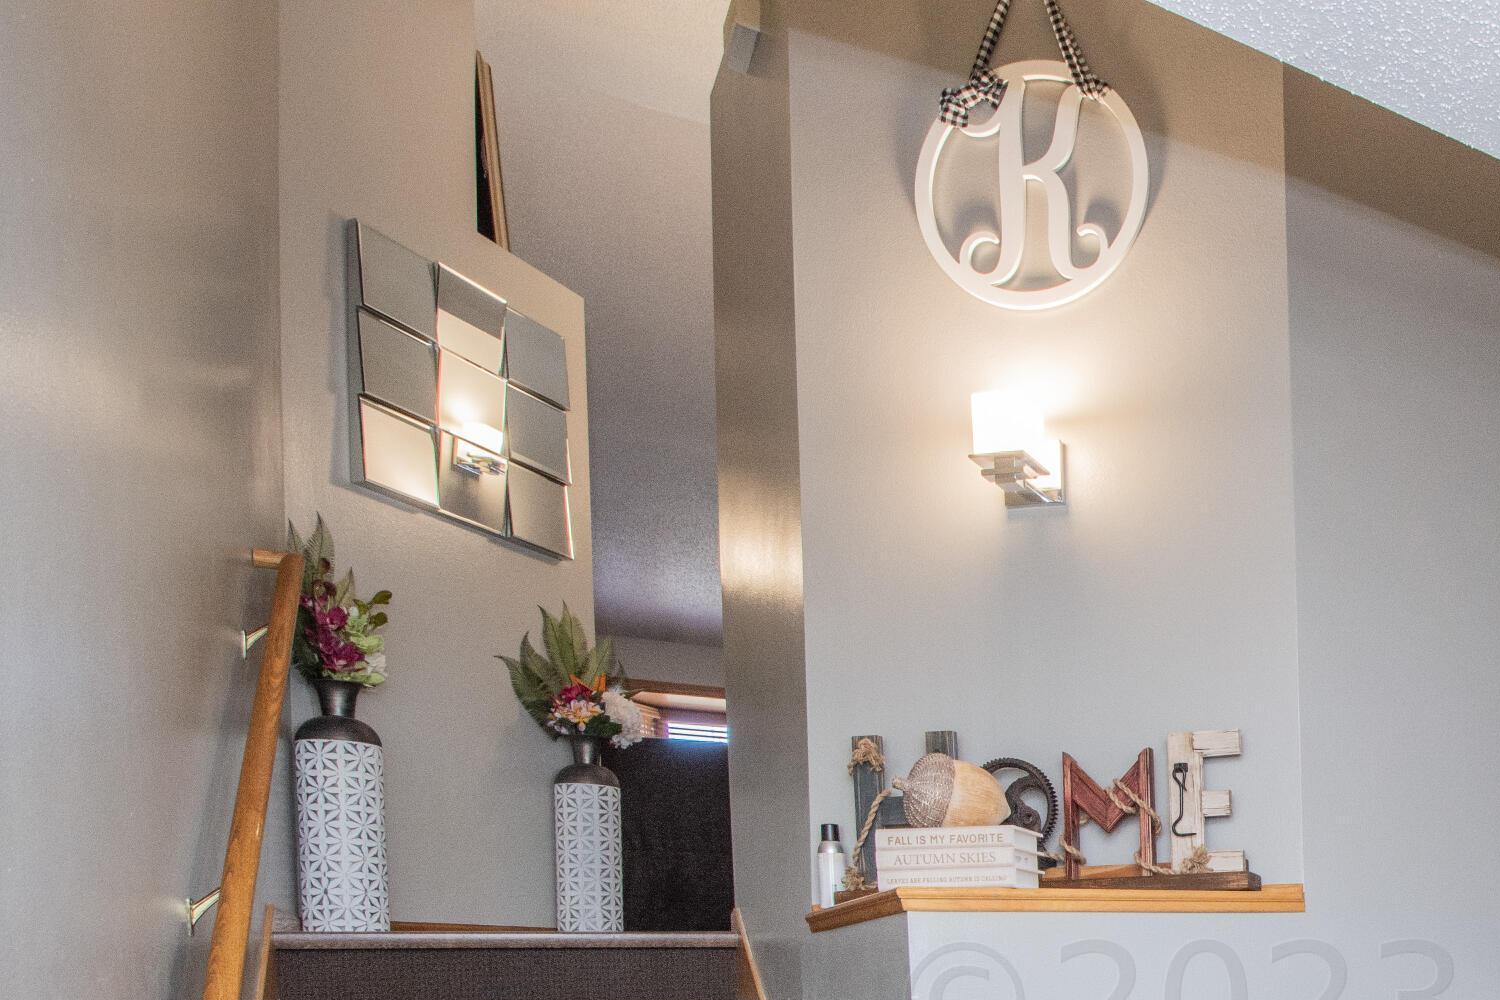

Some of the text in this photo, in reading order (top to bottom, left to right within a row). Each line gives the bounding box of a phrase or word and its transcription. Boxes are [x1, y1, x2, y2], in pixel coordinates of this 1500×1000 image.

[887, 833, 1004, 846] FALL IS MY FAVORITE
[894, 851, 996, 866] AUTUMN SKIES
